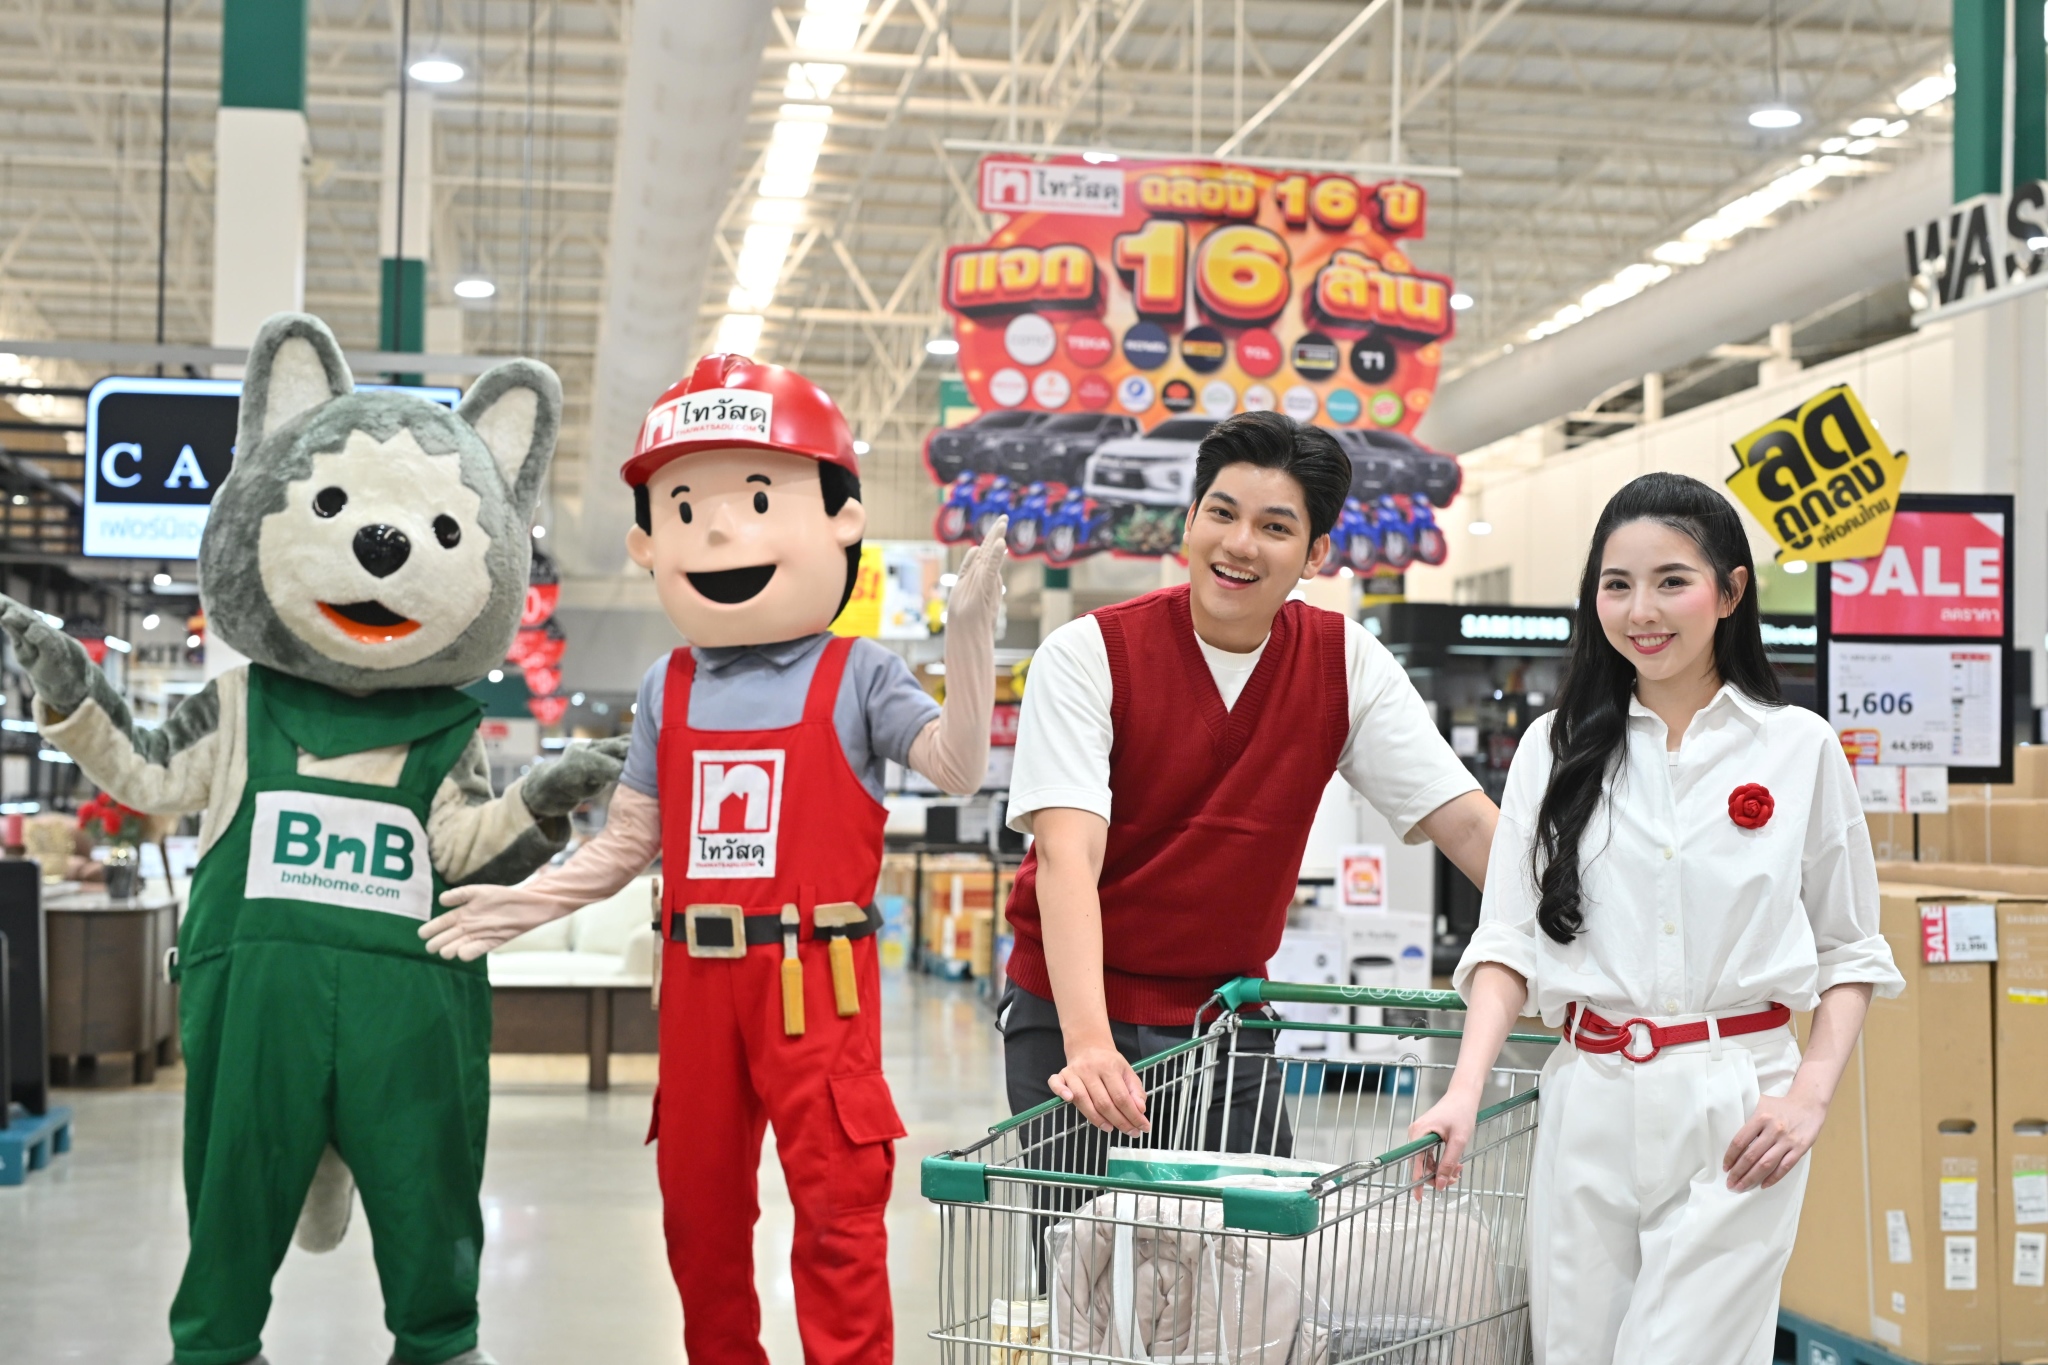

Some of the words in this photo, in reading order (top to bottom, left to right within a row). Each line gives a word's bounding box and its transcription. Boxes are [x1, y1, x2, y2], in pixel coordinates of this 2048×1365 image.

[1035, 169, 1120, 209] ไทวัสดุ
[1275, 174, 1359, 225] 16
[952, 246, 1094, 304] แจก
[1118, 221, 1288, 318] 16
[1322, 251, 1444, 327] ล้าน
[681, 398, 767, 434] ไทวัสดุ
[101, 442, 236, 489] CA
[1748, 392, 1872, 503] ลด
[1773, 456, 1886, 550] ถูกลง
[1816, 497, 1891, 549] เพื่อคนไทย
[1830, 545, 2001, 598] SALE
[1460, 614, 1570, 640] SAMSUNG
[1837, 692, 1914, 719] 1,606
[273, 810, 415, 882] BnB
[697, 836, 765, 867] ไทวัสดุ
[280, 871, 401, 900] bnbhome.com
[1926, 904, 1946, 963] SALE
